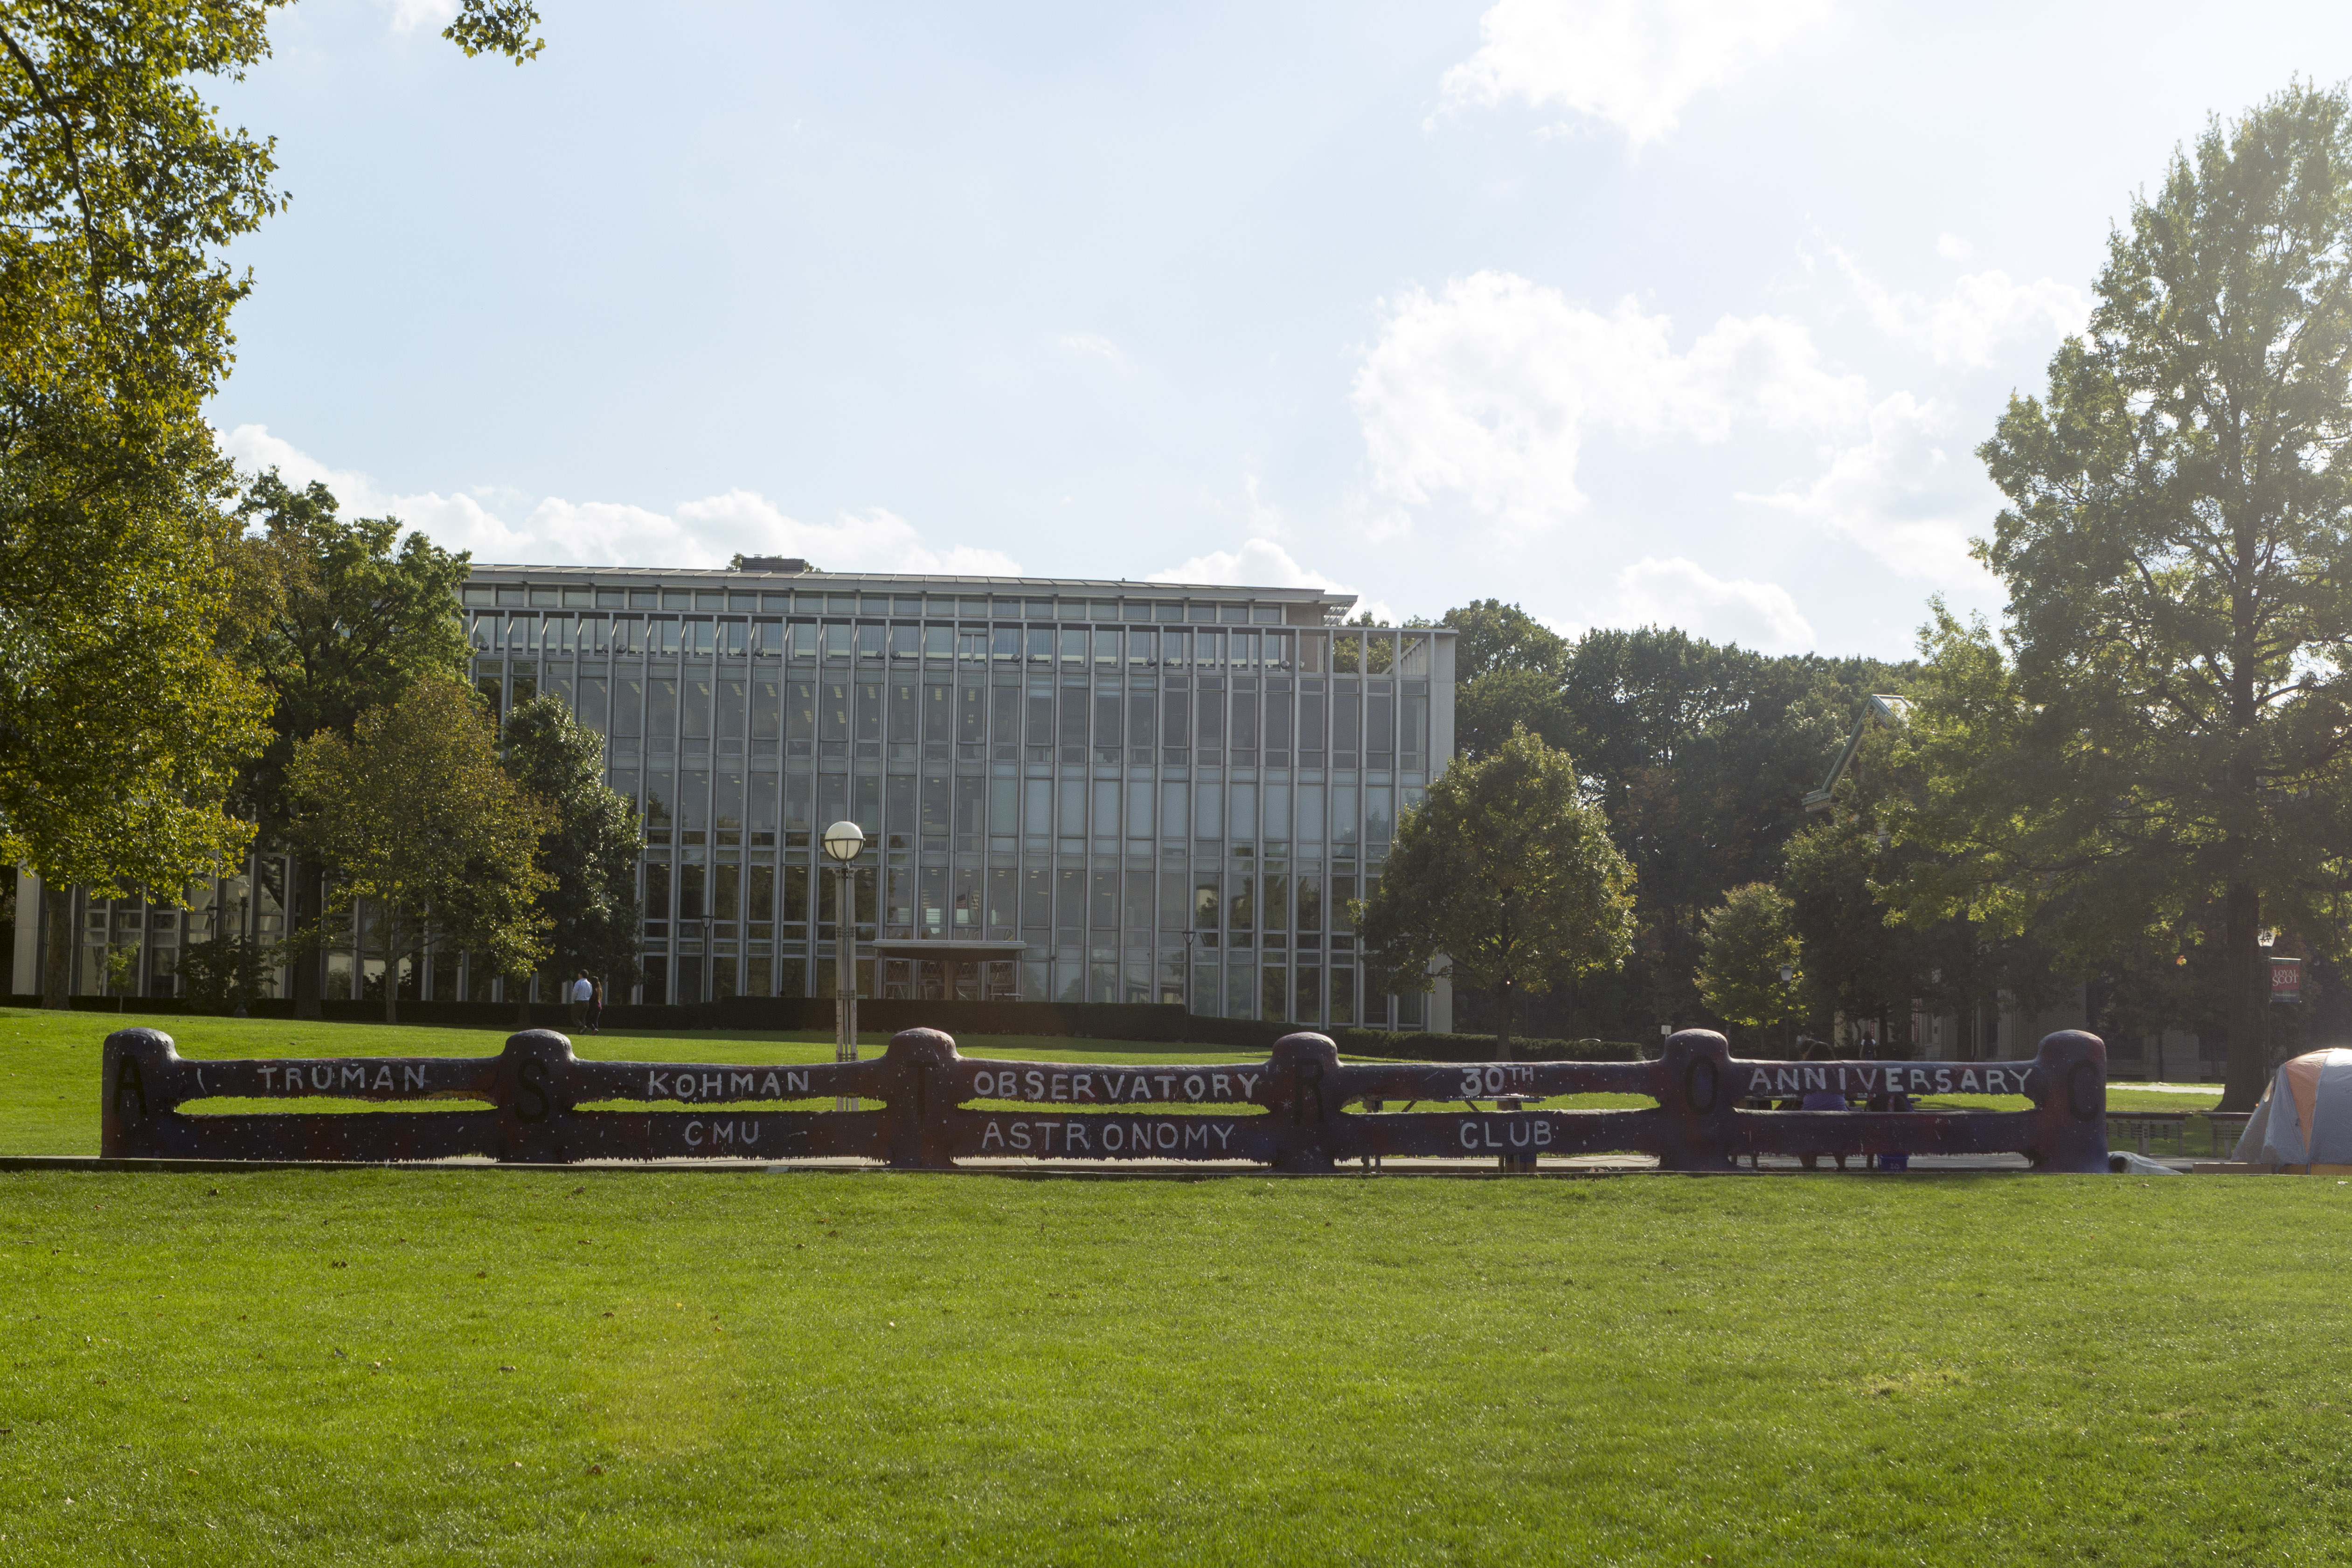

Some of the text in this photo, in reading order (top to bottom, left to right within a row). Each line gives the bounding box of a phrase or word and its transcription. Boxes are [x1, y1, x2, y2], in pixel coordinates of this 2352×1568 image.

[2272, 975, 2299, 986] SCOT
[113, 1055, 147, 1116] A
[515, 1058, 549, 1124] S
[907, 1060, 938, 1117] T
[1295, 1058, 1325, 1125] R
[257, 1065, 2033, 1101] TRUMAN KOHMAN OBSERVATORY 30TH ANNIVERSARY
[684, 1120, 1552, 1151] CMU ASTRONOMY CLUB
